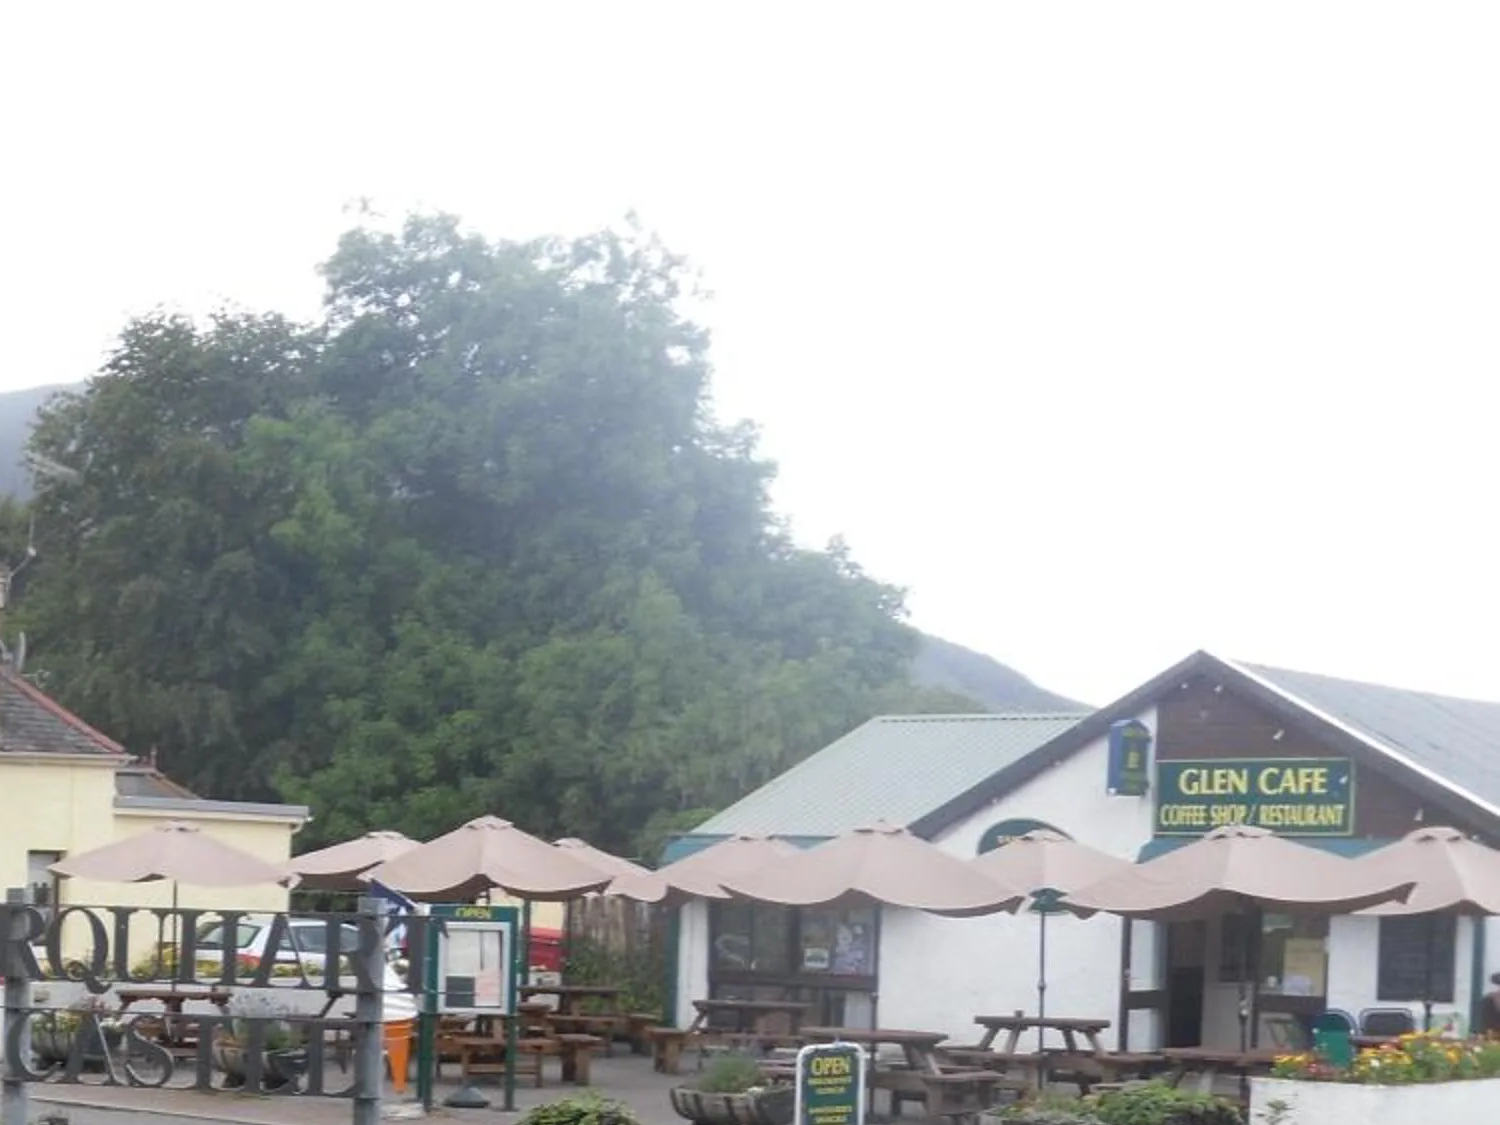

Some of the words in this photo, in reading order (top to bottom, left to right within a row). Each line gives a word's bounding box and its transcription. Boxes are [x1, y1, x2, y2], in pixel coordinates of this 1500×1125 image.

[1178, 767, 1248, 795] GLEN
[1258, 767, 1328, 795] CAFE
[1160, 804, 1206, 827] COFFEE
[1210, 804, 1247, 826] SHOP
[1258, 803, 1345, 827] RESTAURANT
[4, 1007, 365, 1098] CASTLE
[811, 1056, 852, 1075] OPEN
